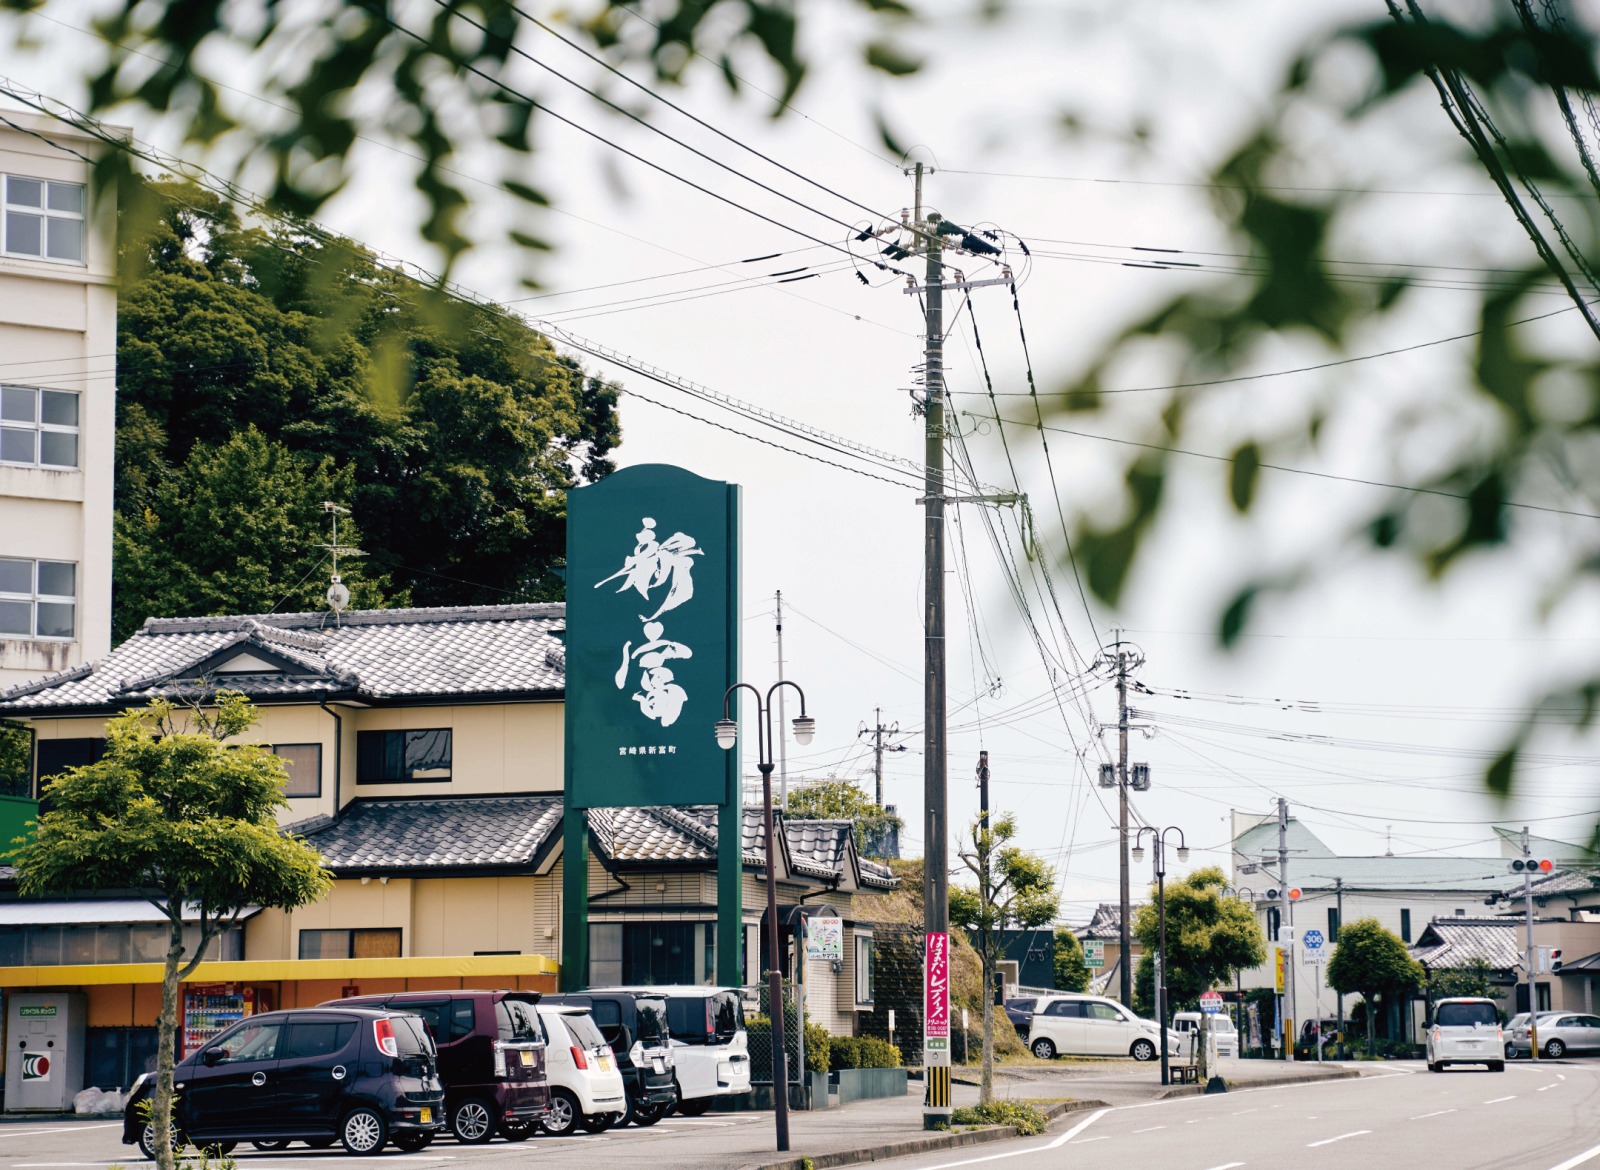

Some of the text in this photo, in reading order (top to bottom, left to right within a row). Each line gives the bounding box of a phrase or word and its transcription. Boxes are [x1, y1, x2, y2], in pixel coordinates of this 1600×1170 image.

[594, 517, 705, 727] 新富
[619, 745, 677, 756] 宮崎県新富町
[1305, 935, 1322, 943] 306
